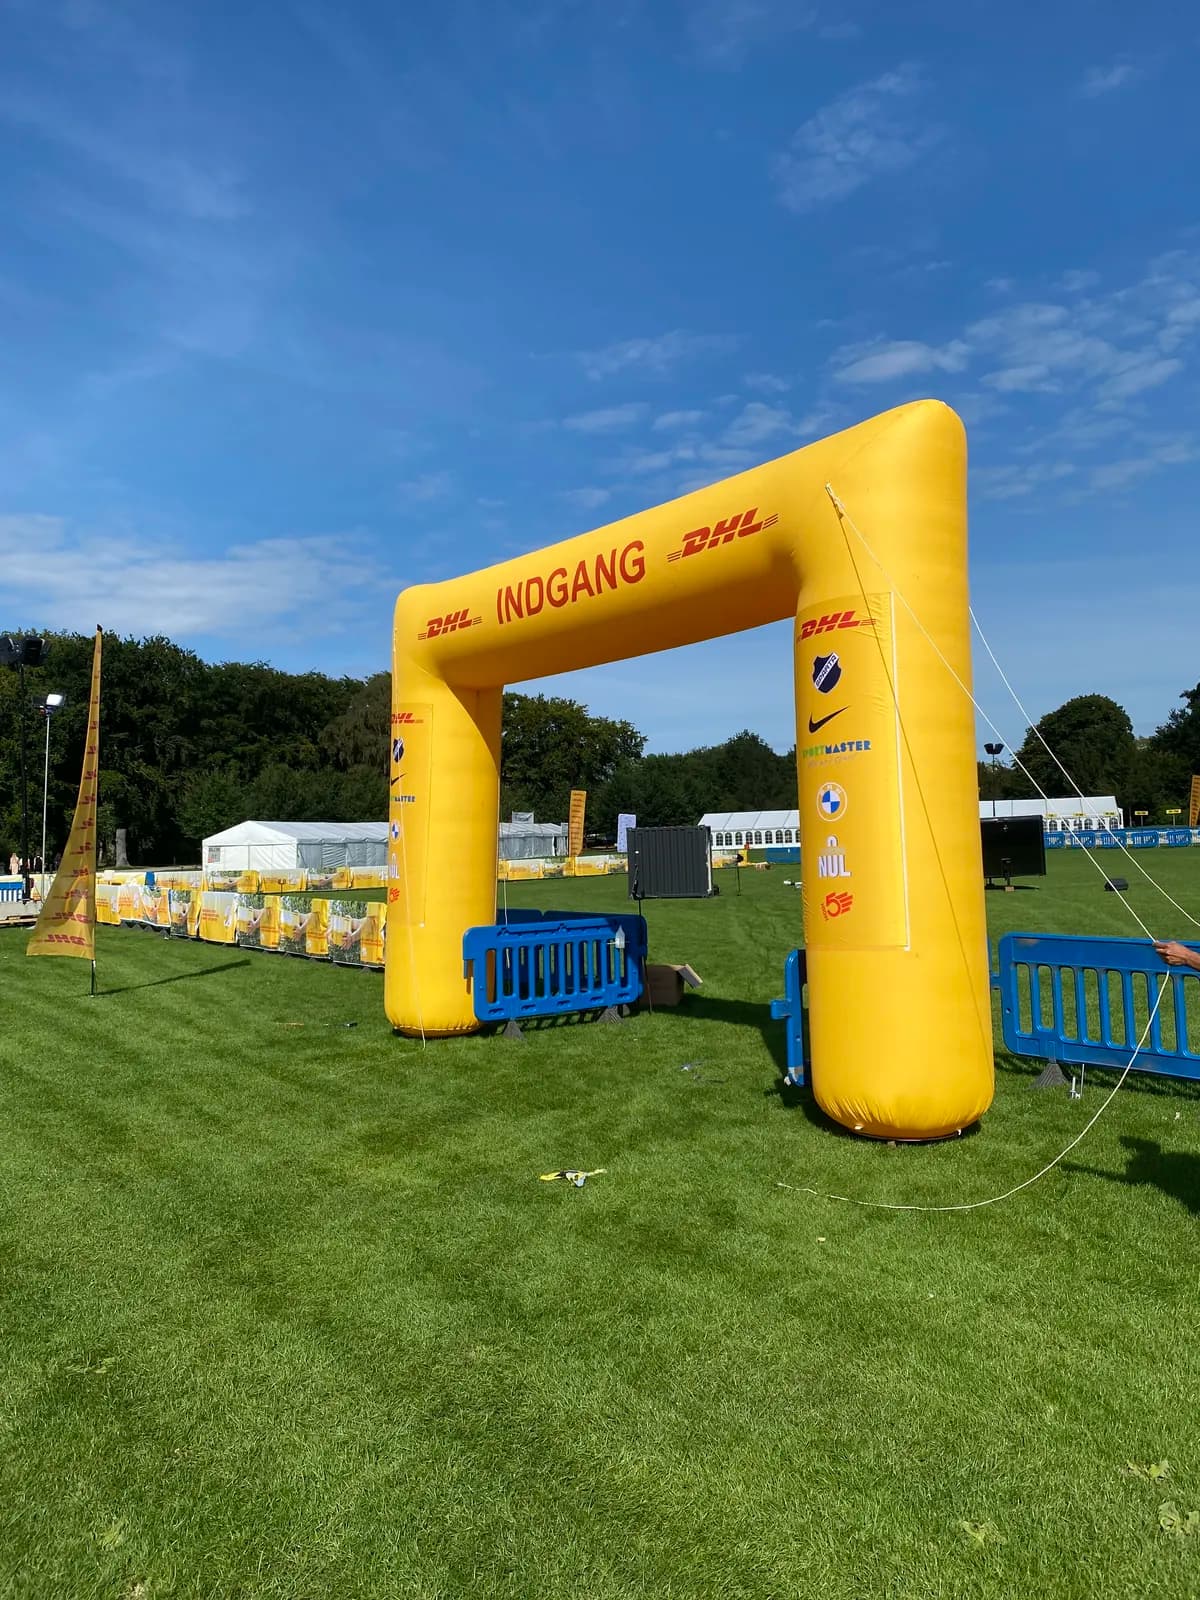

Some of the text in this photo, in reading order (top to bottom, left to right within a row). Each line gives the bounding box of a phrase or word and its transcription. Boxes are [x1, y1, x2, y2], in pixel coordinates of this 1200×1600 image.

[681, 507, 764, 558] DHL
[496, 540, 646, 625] INDGANG
[426, 608, 473, 640] DHL
[800, 611, 860, 640] DHL
[815, 653, 838, 688] SPARTA
[818, 855, 851, 879] NUL
